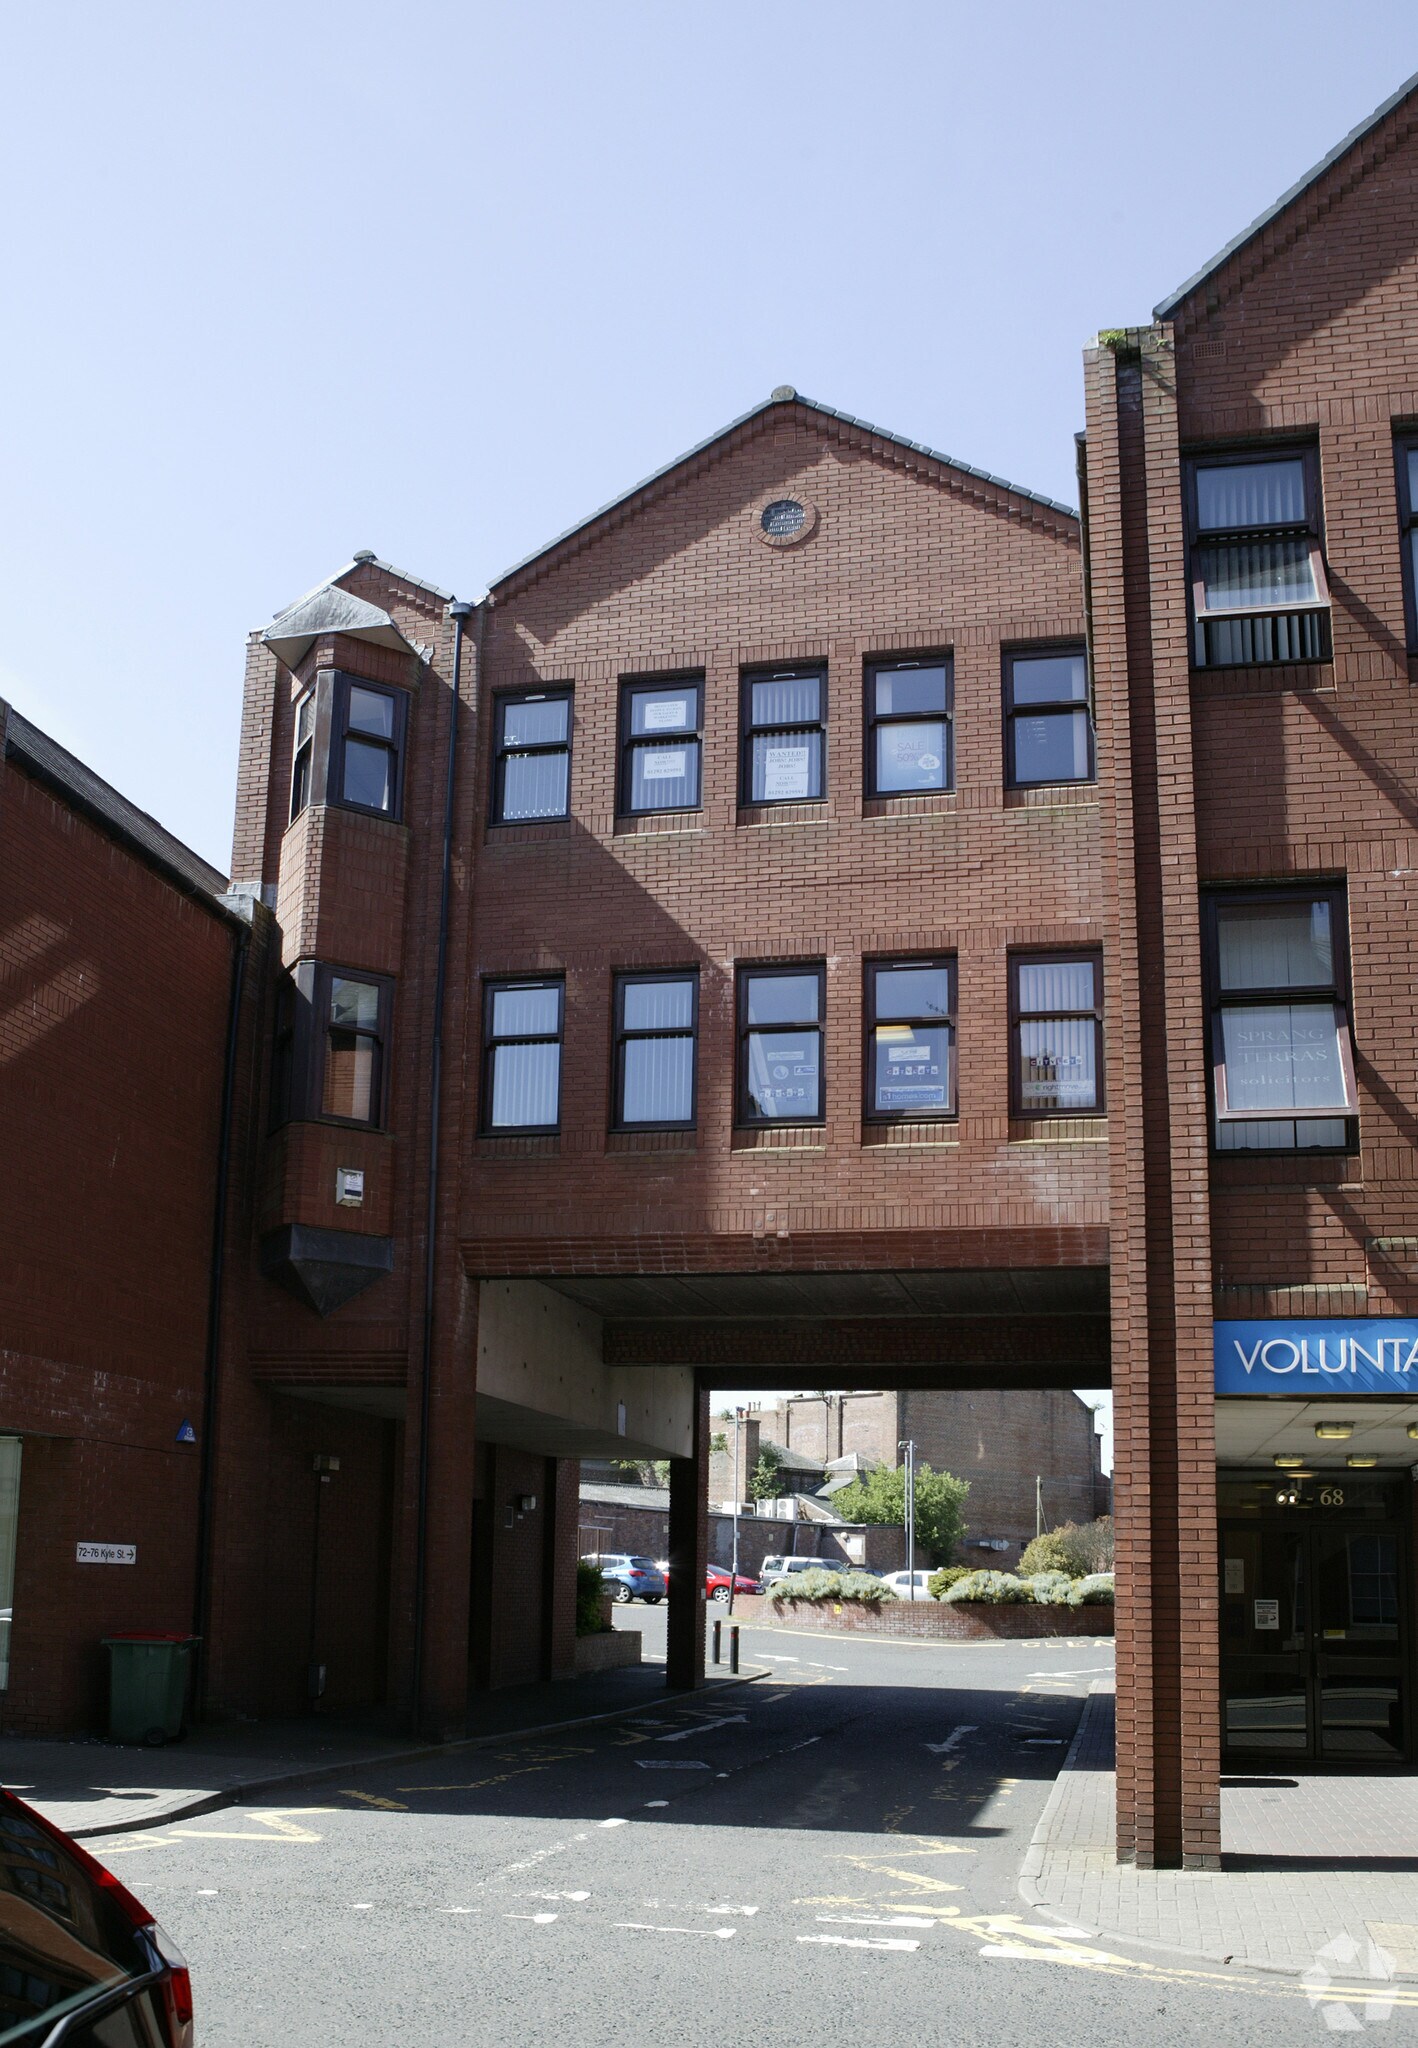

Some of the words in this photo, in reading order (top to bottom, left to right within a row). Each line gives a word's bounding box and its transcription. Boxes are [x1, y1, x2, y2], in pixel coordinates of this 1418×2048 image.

[897, 741, 925, 751] SALE
[1238, 1029, 1323, 1041] SPRANG
[1030, 1056, 1082, 1066] CITYLETS
[1238, 1049, 1328, 1063] TERRAS
[1240, 1074, 1330, 1085] solicitors
[1320, 1489, 1344, 1506] 68
[78, 1547, 99, 1558] 72-76
[100, 1549, 115, 1560] Kyle
